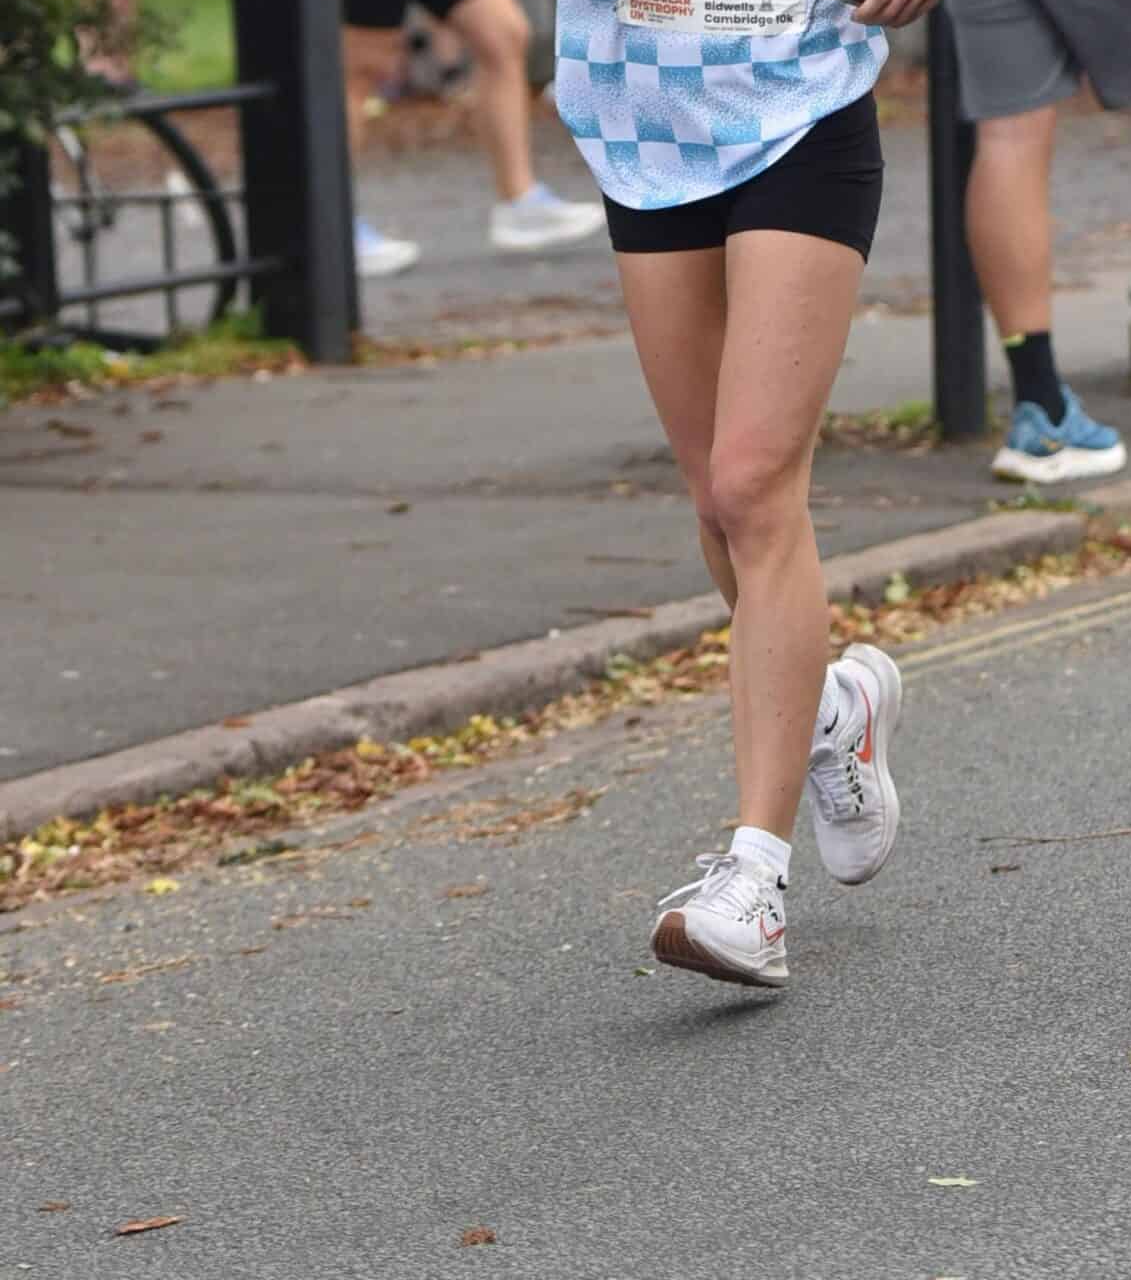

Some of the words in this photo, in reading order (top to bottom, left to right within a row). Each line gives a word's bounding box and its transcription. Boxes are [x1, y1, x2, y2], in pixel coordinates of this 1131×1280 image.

[629, 0, 695, 17] DYSTROPHY
[704, 1, 754, 12] Bidwells
[704, 15, 773, 27] Cambridge
[775, 15, 793, 24] 10k
